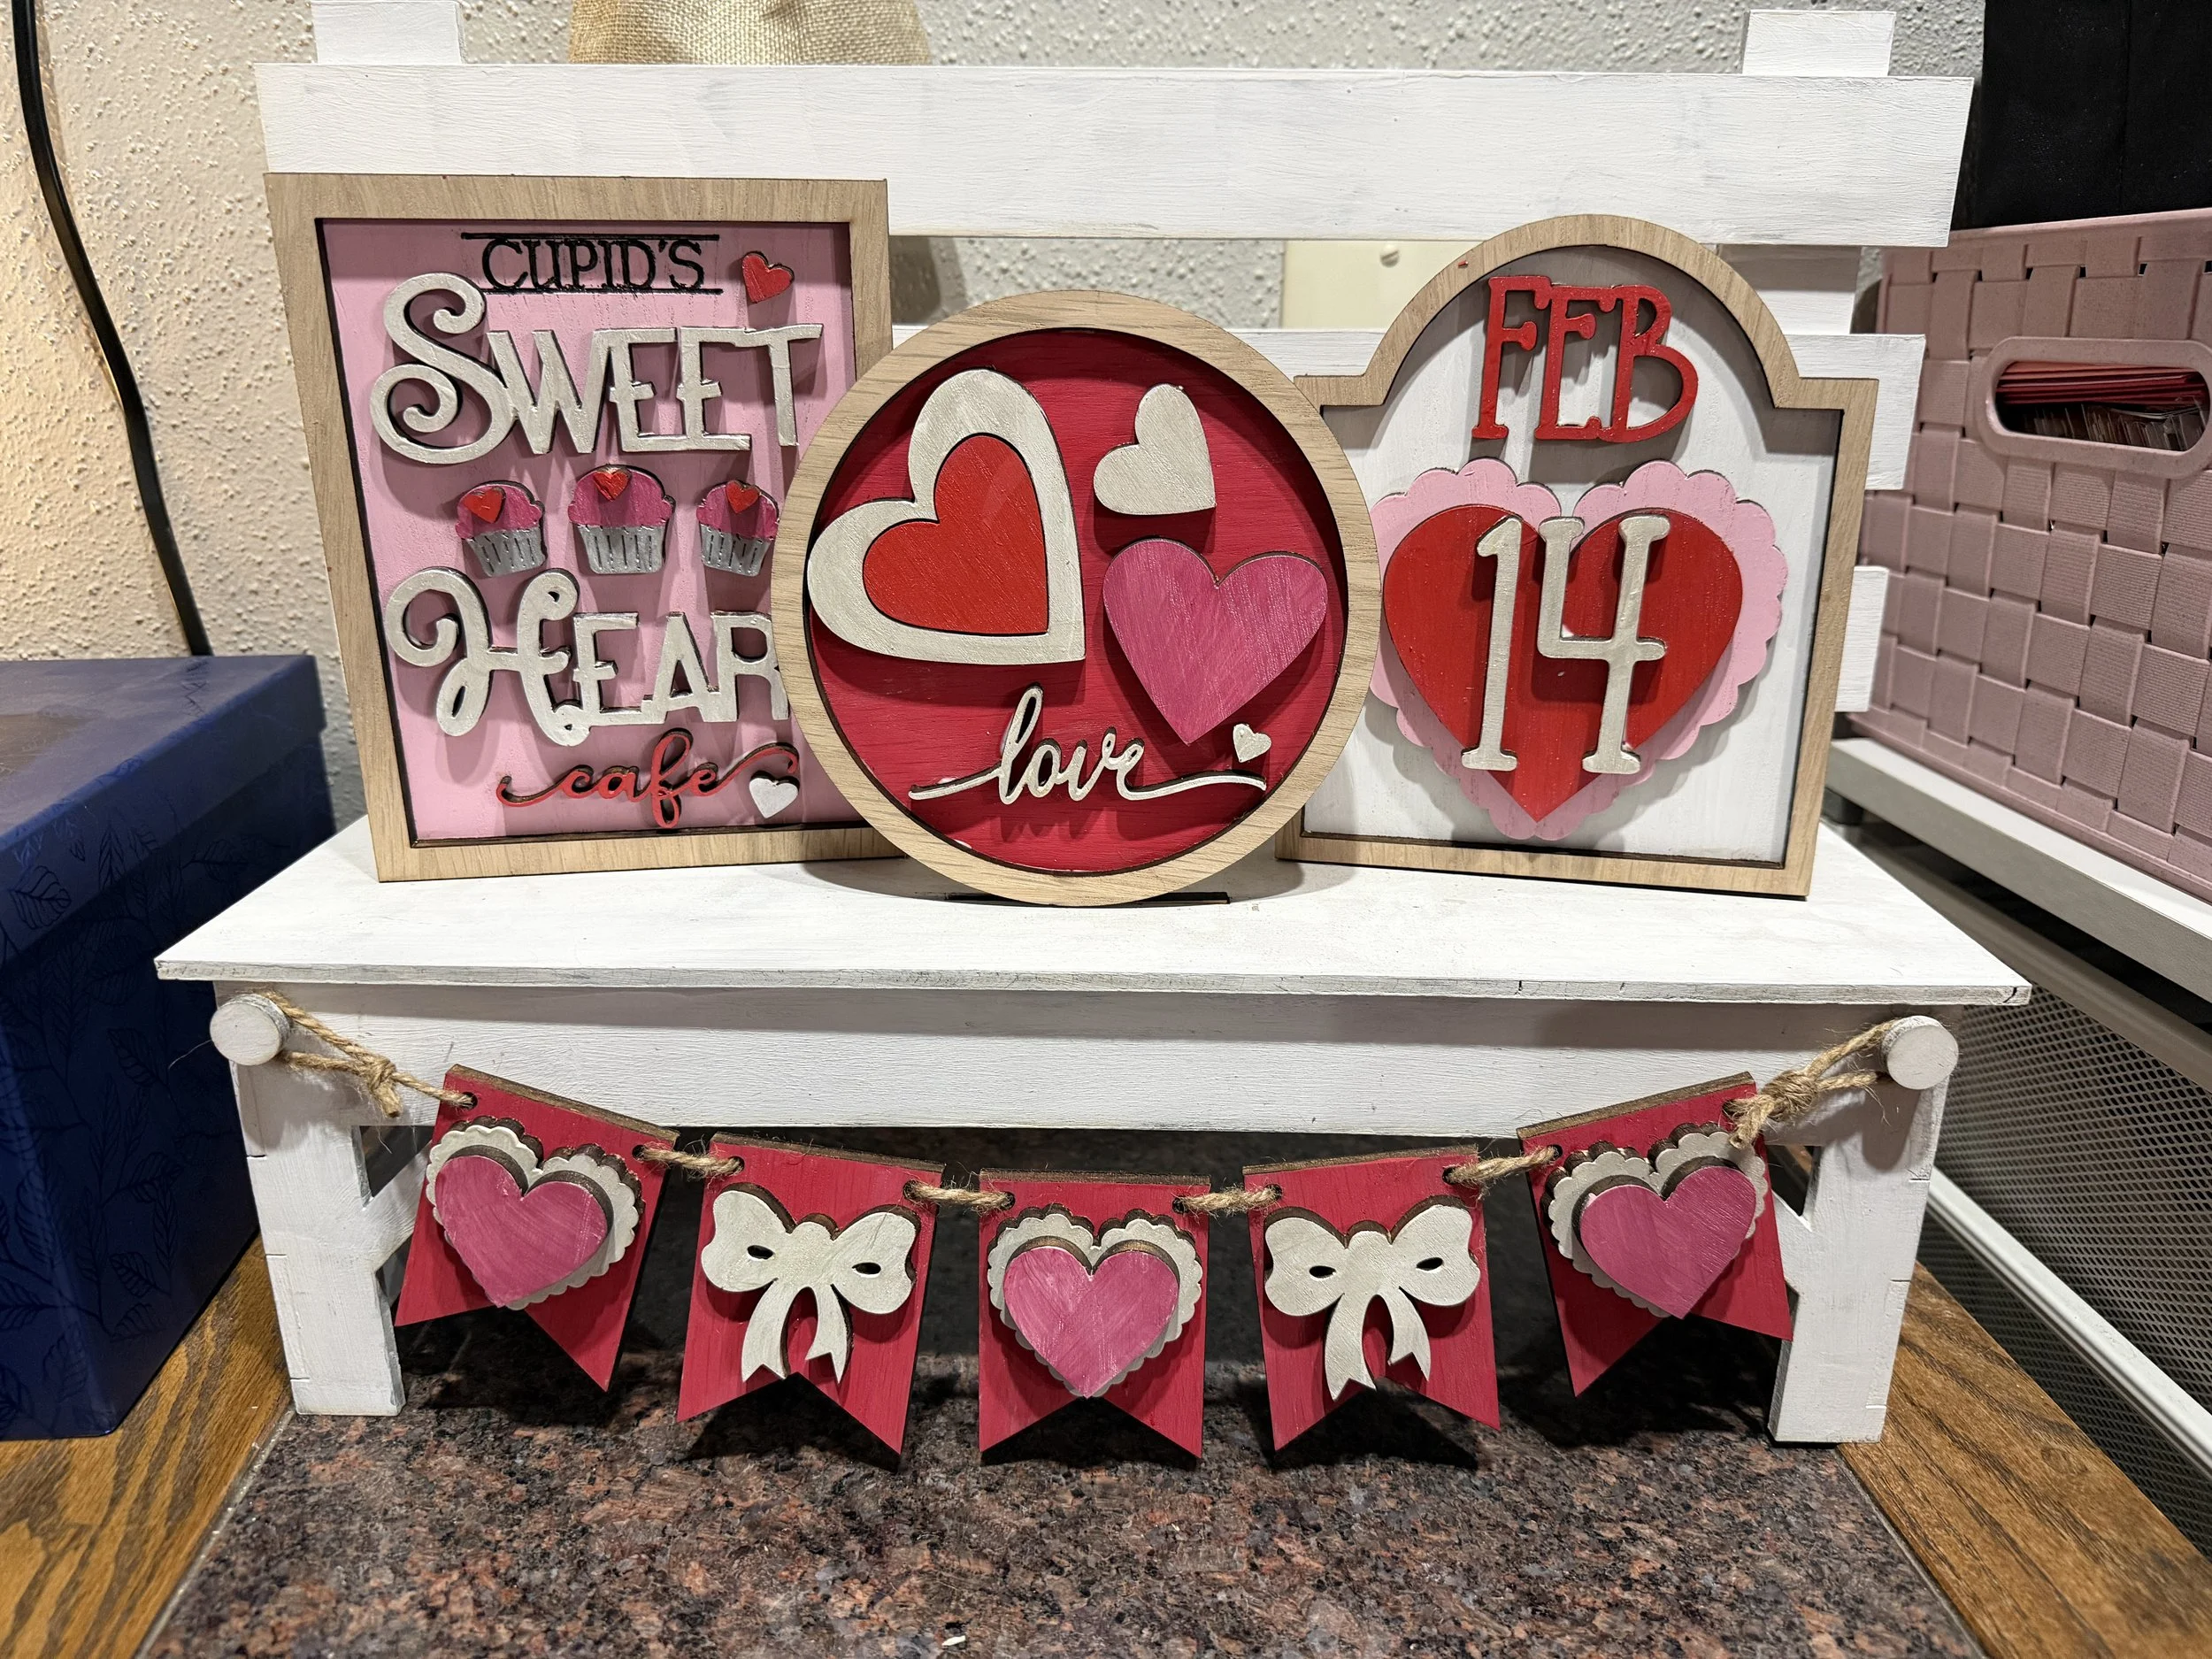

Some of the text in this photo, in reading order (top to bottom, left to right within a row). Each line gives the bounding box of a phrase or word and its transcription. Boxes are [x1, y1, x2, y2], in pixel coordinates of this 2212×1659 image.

[481, 237, 708, 291] CUPID'S
[369, 272, 824, 465] SWEET
[1471, 274, 1699, 443] FEB
[385, 566, 790, 747] HEAR
[1461, 514, 1671, 776] 14
[495, 727, 800, 829] cafe
[908, 683, 1267, 805] love
